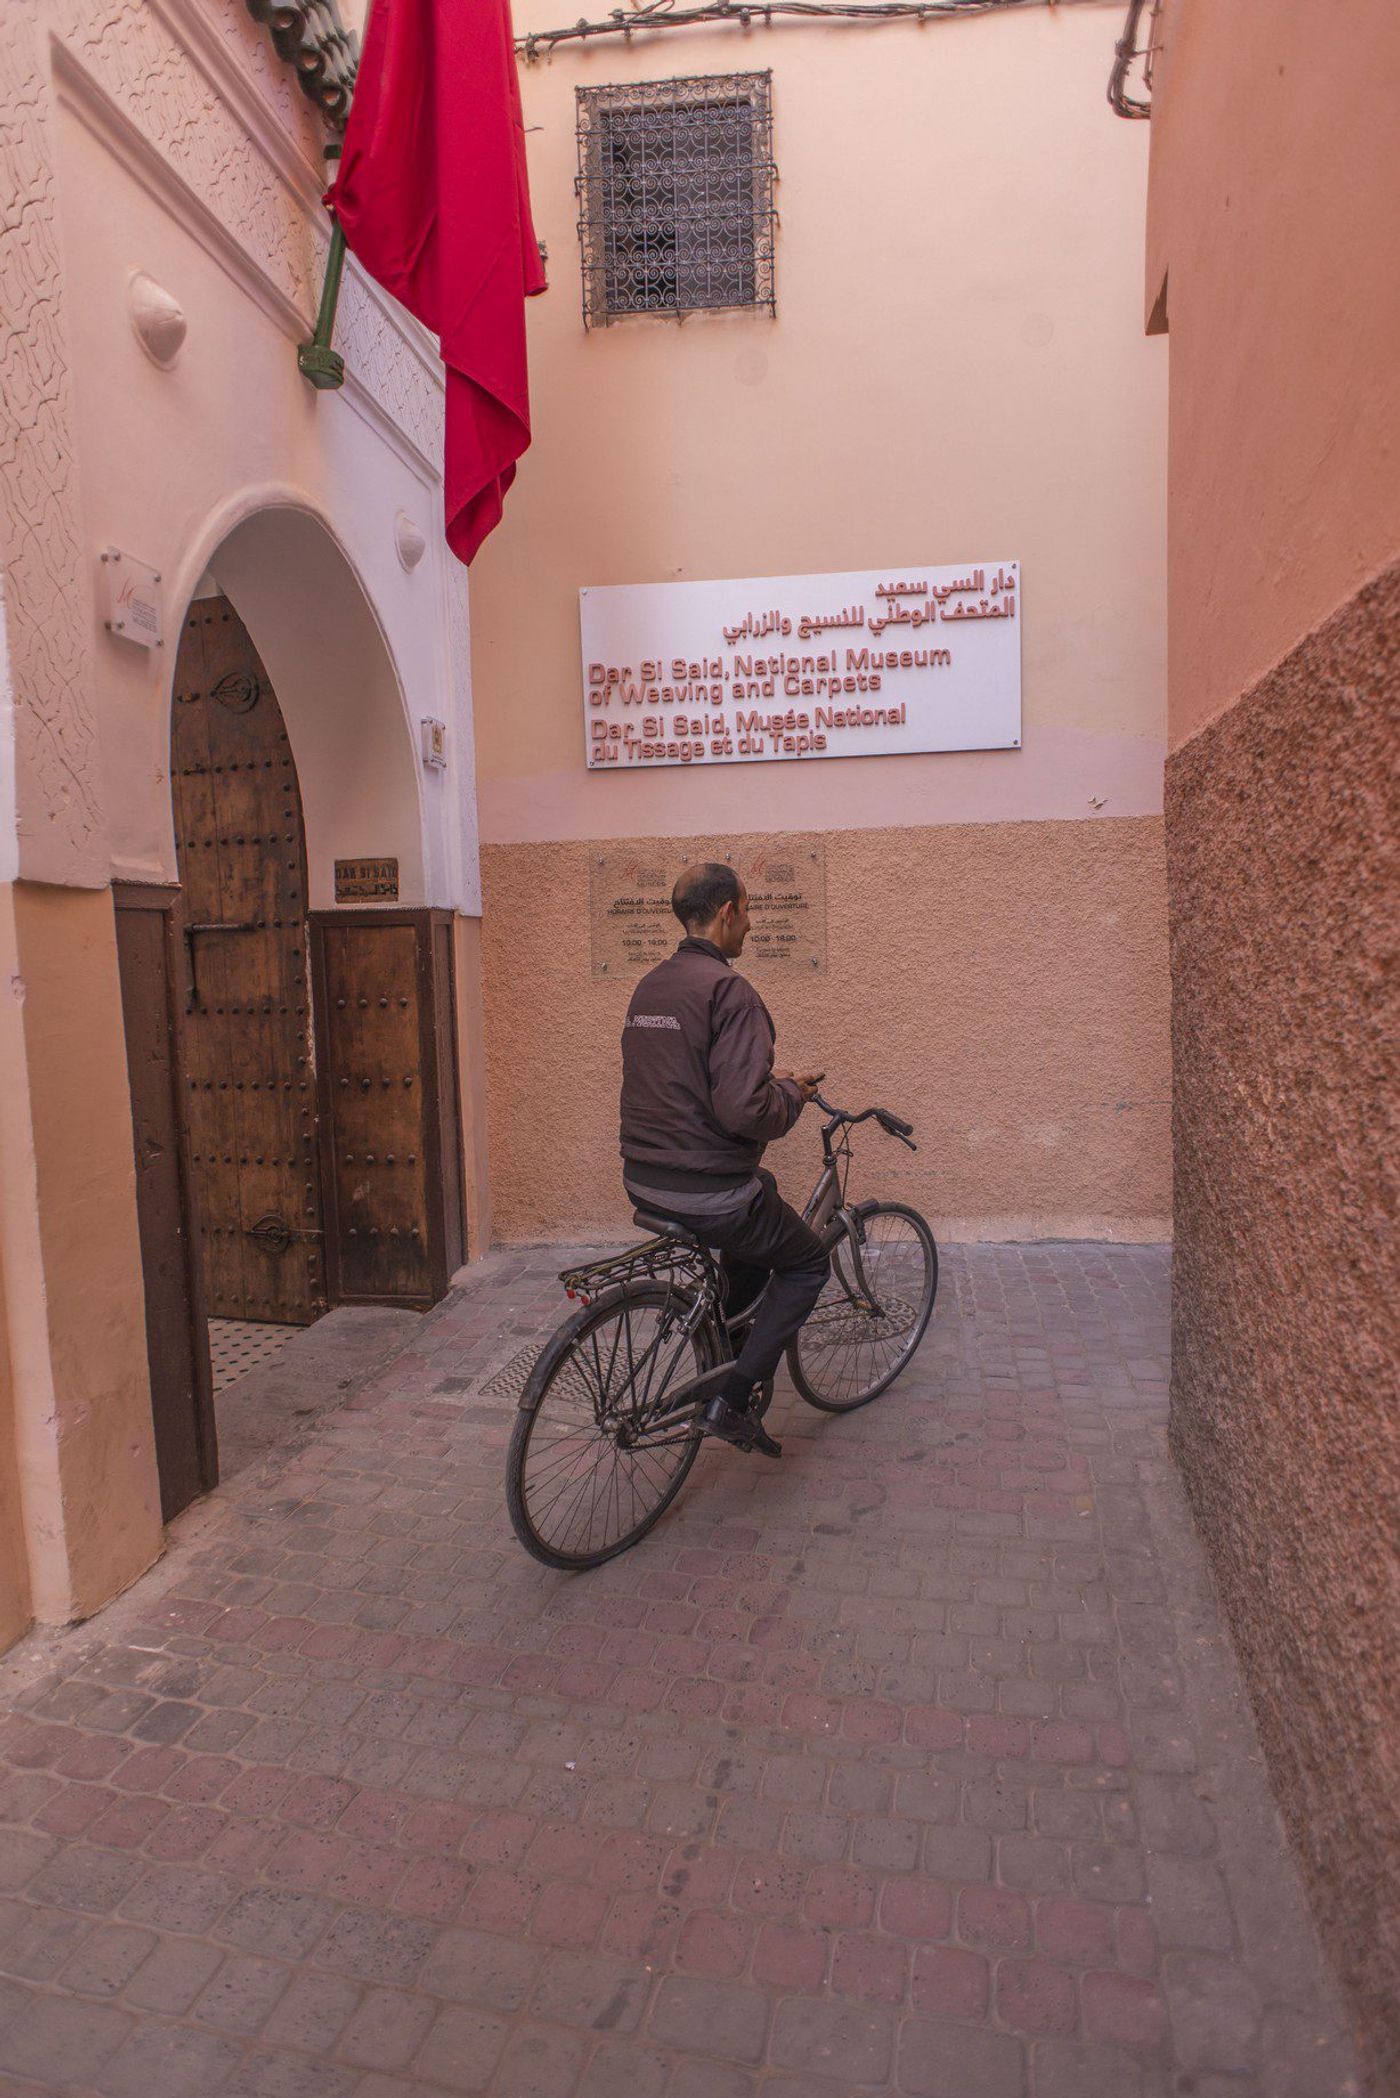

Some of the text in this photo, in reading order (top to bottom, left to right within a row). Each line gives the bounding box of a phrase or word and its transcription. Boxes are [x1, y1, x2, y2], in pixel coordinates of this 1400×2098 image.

[875, 568, 1015, 605] دار السي سعيد
[723, 596, 1015, 645] المتحف الوطني للنسيج والزرابي
[588, 647, 951, 684] Dar Si Said, National Museum
[589, 672, 882, 706] of Weaving and Carpets
[591, 703, 906, 740] Dar Si Said, Musée National
[592, 729, 827, 761] du Tissage et du Tapis
